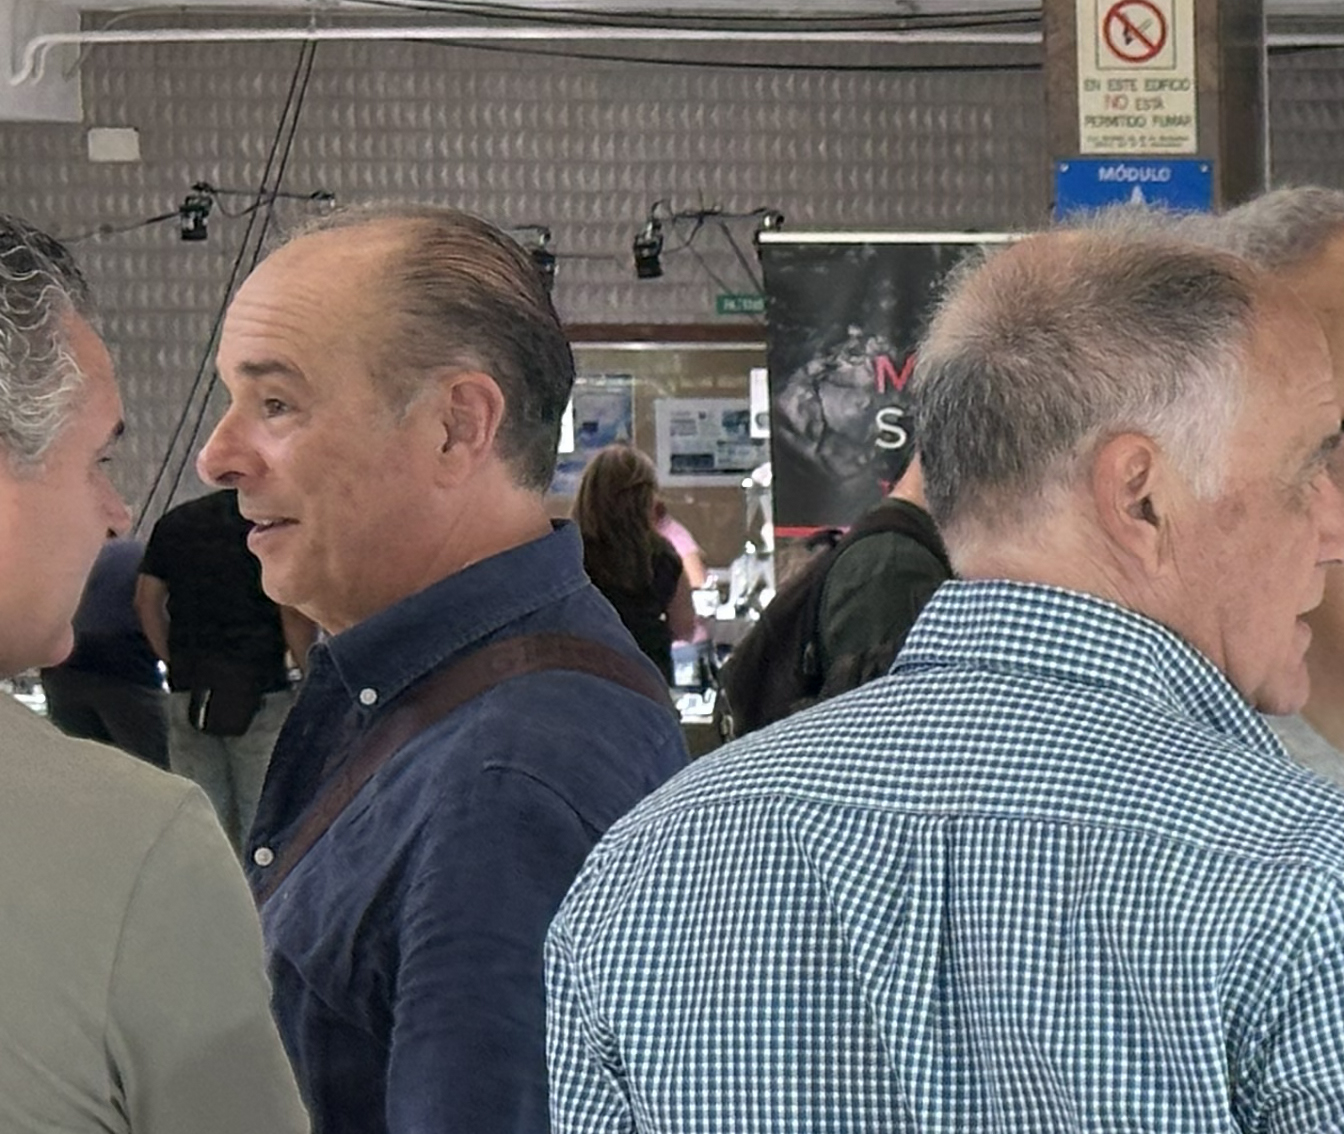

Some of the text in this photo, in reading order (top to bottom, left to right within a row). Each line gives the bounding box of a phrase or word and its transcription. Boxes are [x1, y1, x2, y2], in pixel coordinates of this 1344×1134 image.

[1084, 78, 1190, 92] EN ESTE EDIFICIO
[1105, 93, 1129, 111] NO
[1084, 115, 1191, 128] PERMITIDO FUMAR
[1098, 164, 1170, 181] MÓDULO
